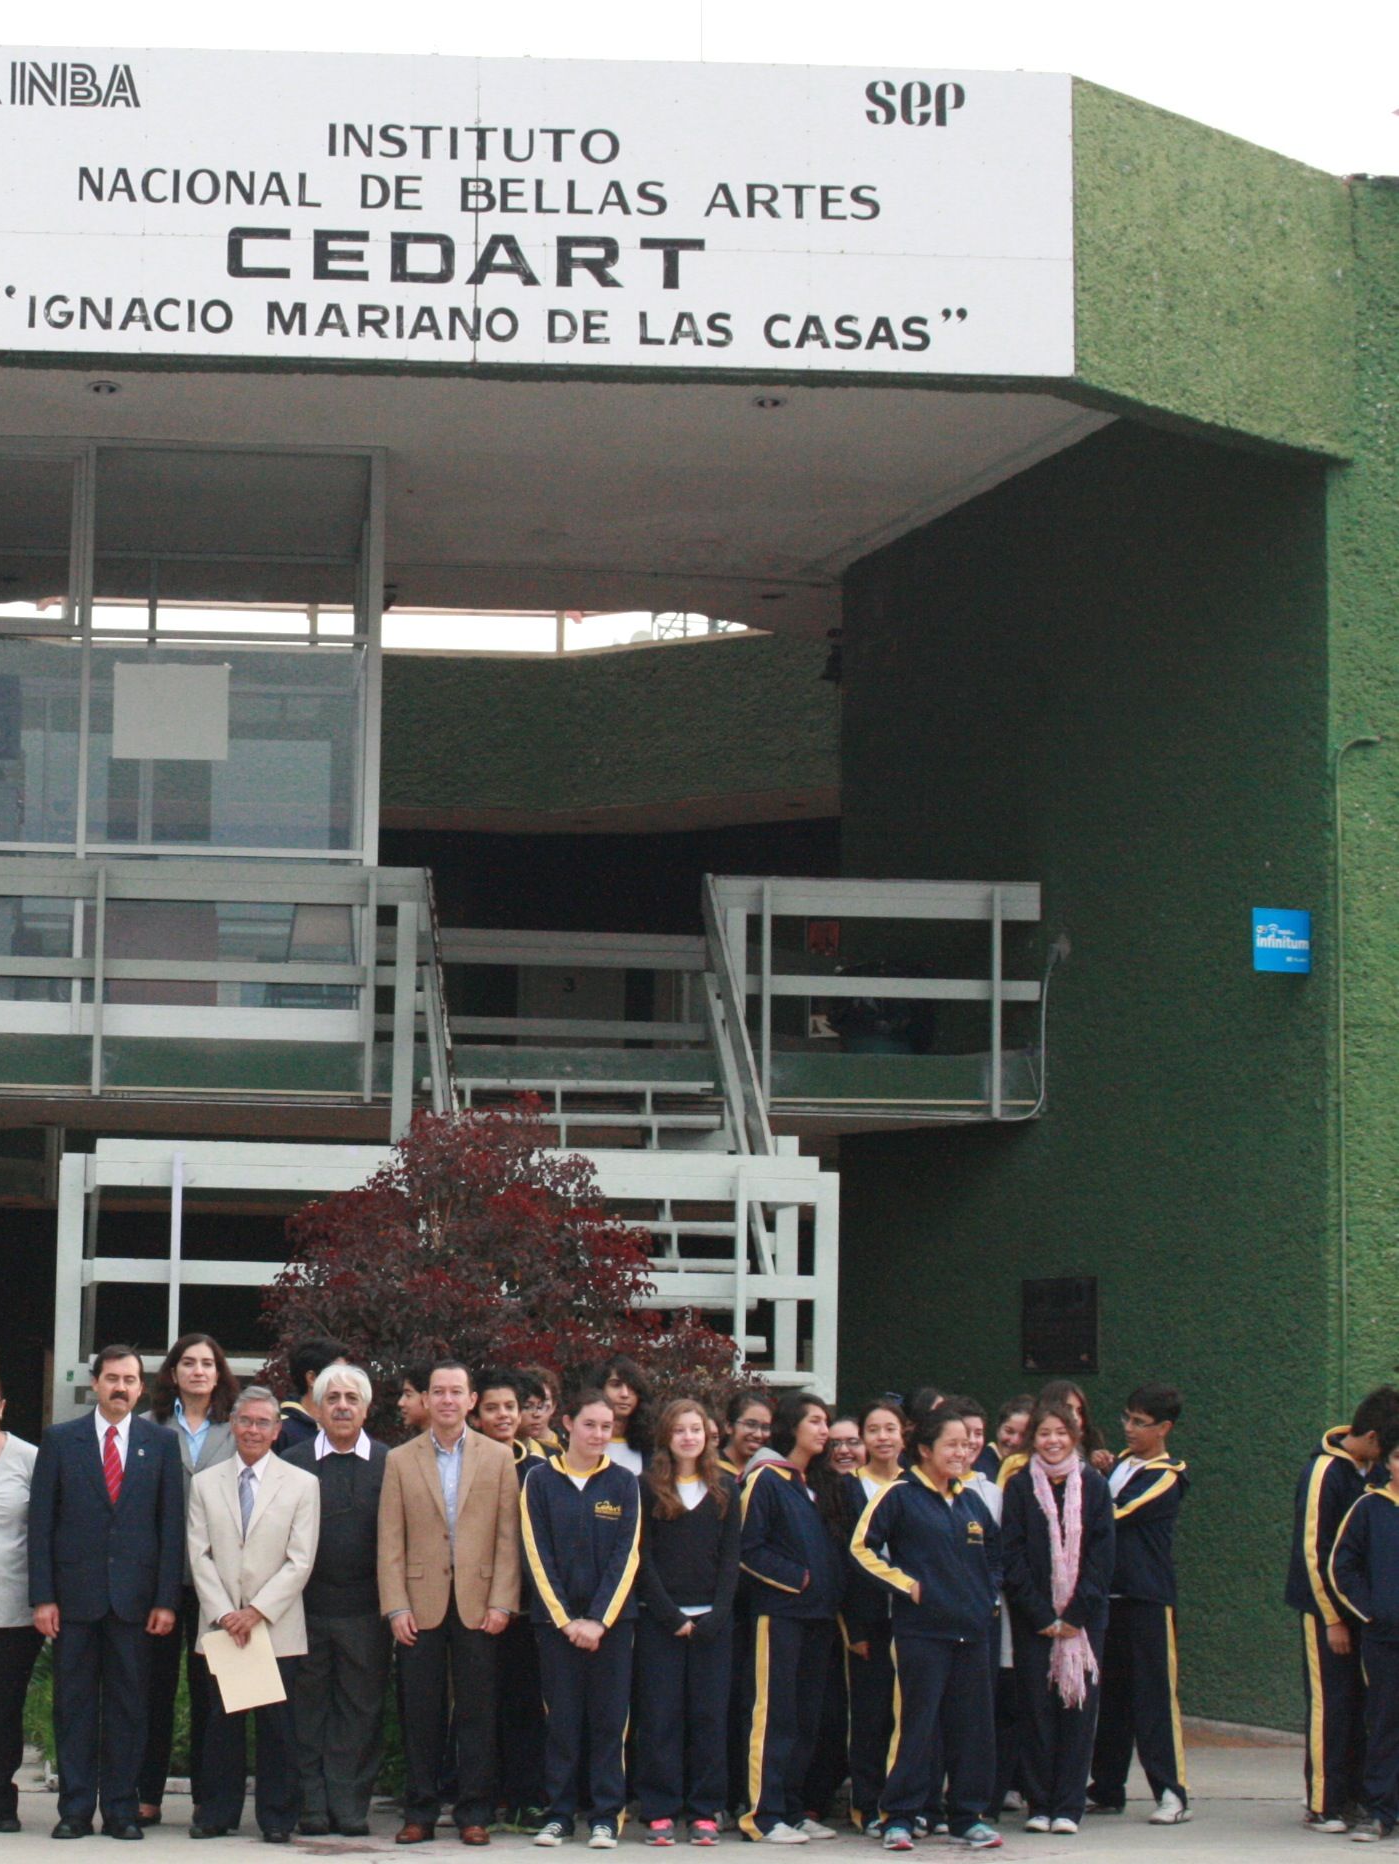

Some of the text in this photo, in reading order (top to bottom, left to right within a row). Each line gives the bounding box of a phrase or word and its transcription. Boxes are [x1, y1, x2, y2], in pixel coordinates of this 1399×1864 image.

[10, 62, 141, 108] INBA
[328, 123, 620, 164] INSTITUTO
[79, 166, 880, 220] NACIONAL DE BELLAS ARTES
[226, 227, 706, 290] CEDART
[267, 301, 519, 343] MARIANO
[547, 309, 605, 344] DE
[639, 312, 733, 348] LAS
[1257, 934, 1310, 950] infinitum
